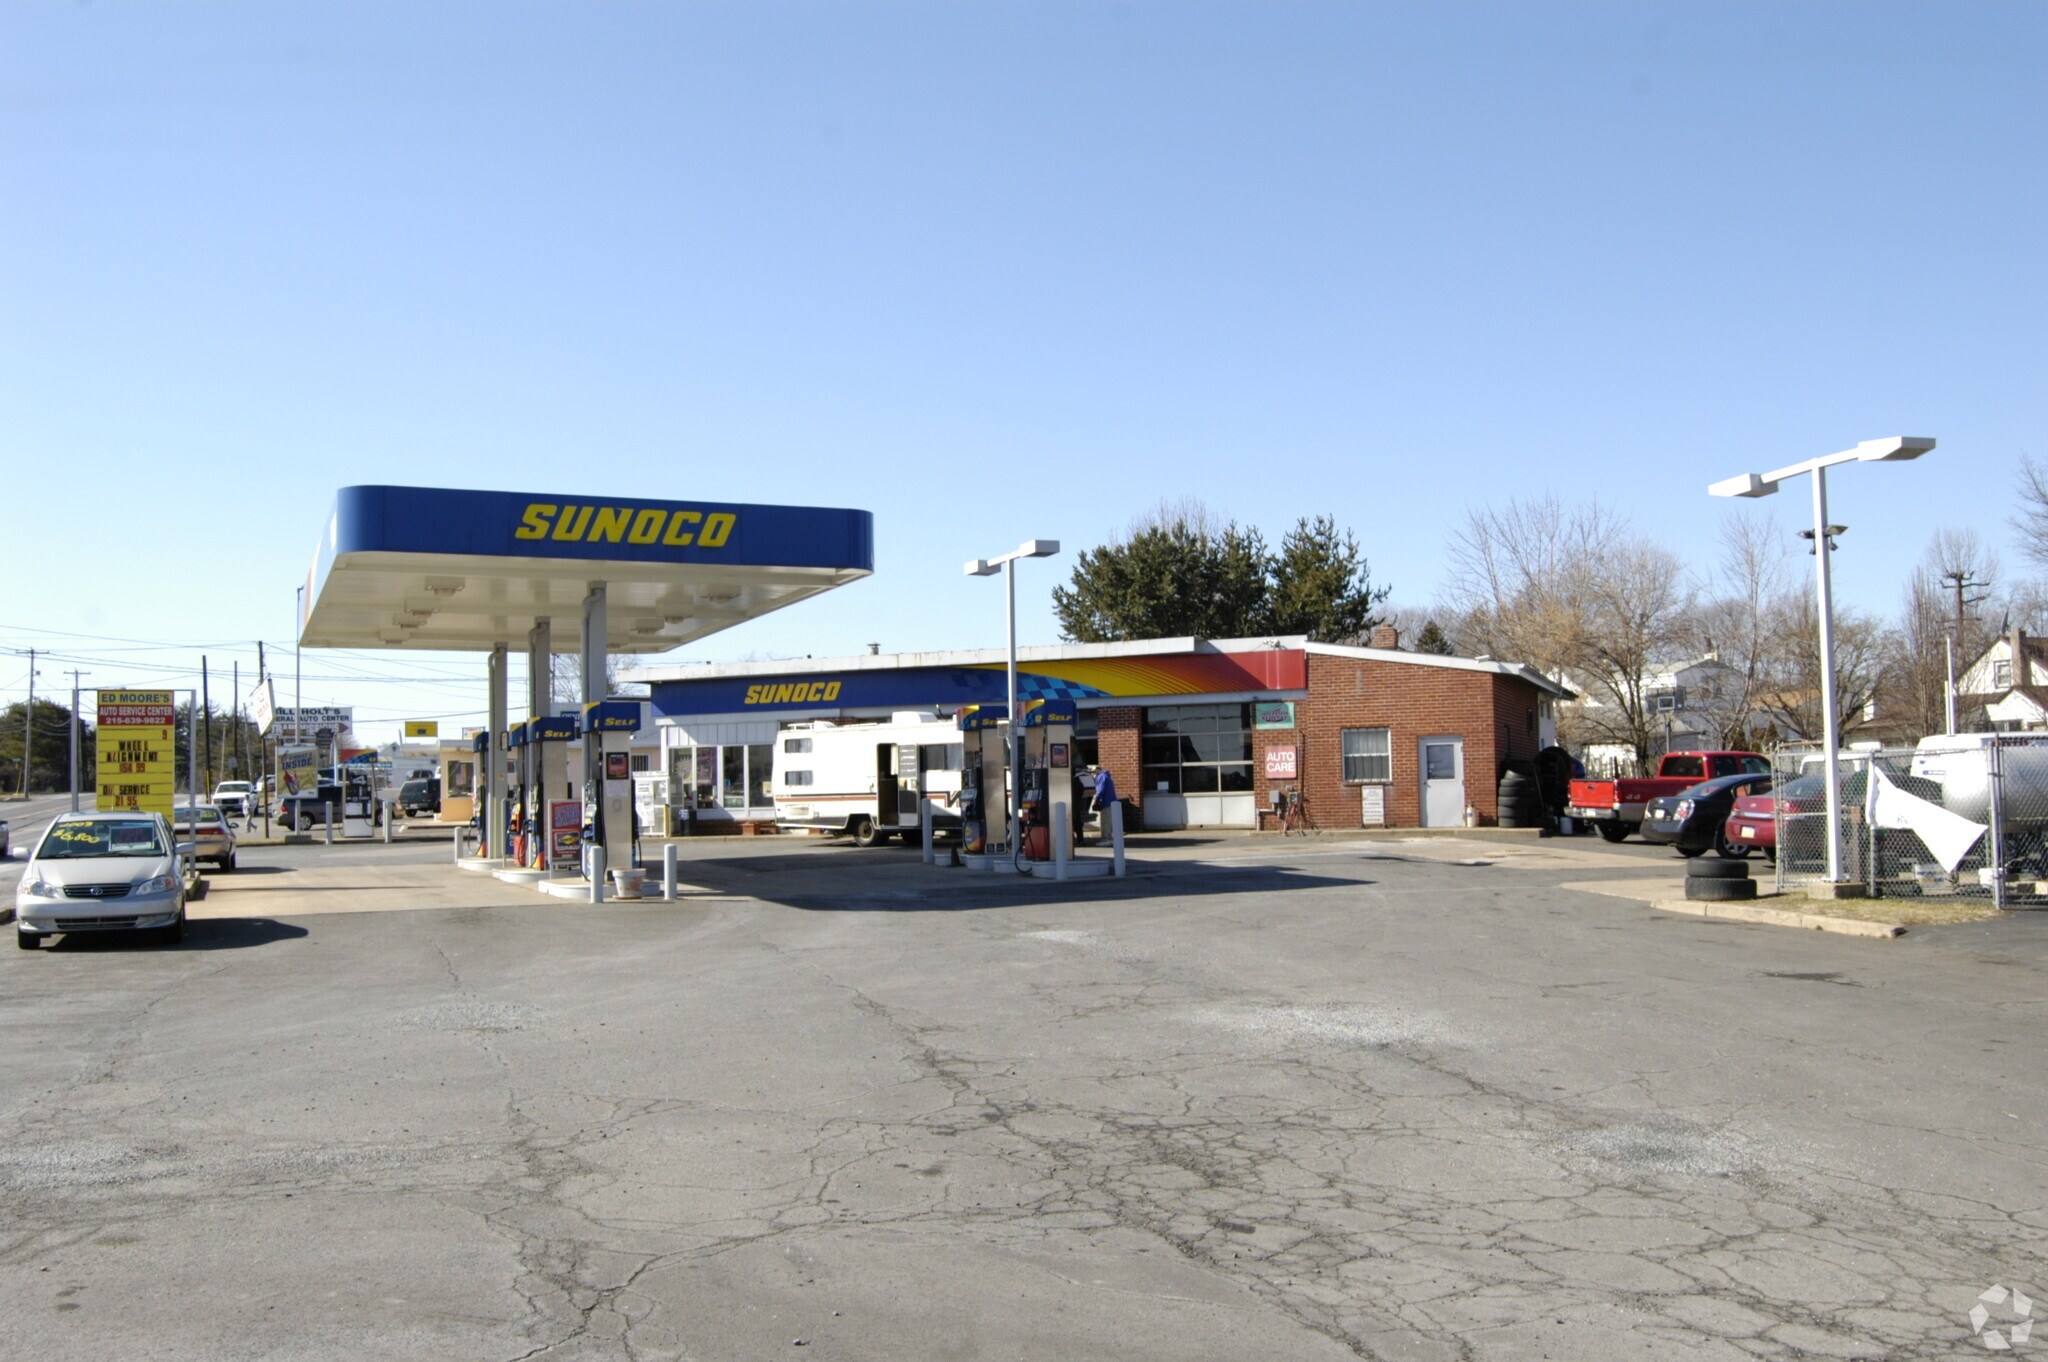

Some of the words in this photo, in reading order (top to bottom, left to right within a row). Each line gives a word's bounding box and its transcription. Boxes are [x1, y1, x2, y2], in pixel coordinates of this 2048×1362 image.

[514, 502, 737, 548] SUNOCO
[744, 680, 842, 705] SUNOCO
[101, 693, 116, 703] ED
[119, 693, 170, 703] MOORE'S
[99, 706, 118, 716] AUTO
[118, 706, 146, 716] SERVICE
[147, 706, 173, 716] CENTER
[105, 716, 166, 725] 215-639-9822
[603, 717, 637, 727] SELF
[1047, 713, 1073, 722] SELF
[543, 730, 572, 738] SELF
[106, 751, 159, 762] ALIGNMENT
[1266, 751, 1295, 762] AUTO
[282, 758, 313, 770] INSIDE
[1266, 762, 1296, 772] CARE
[119, 784, 151, 796] SERVICE
